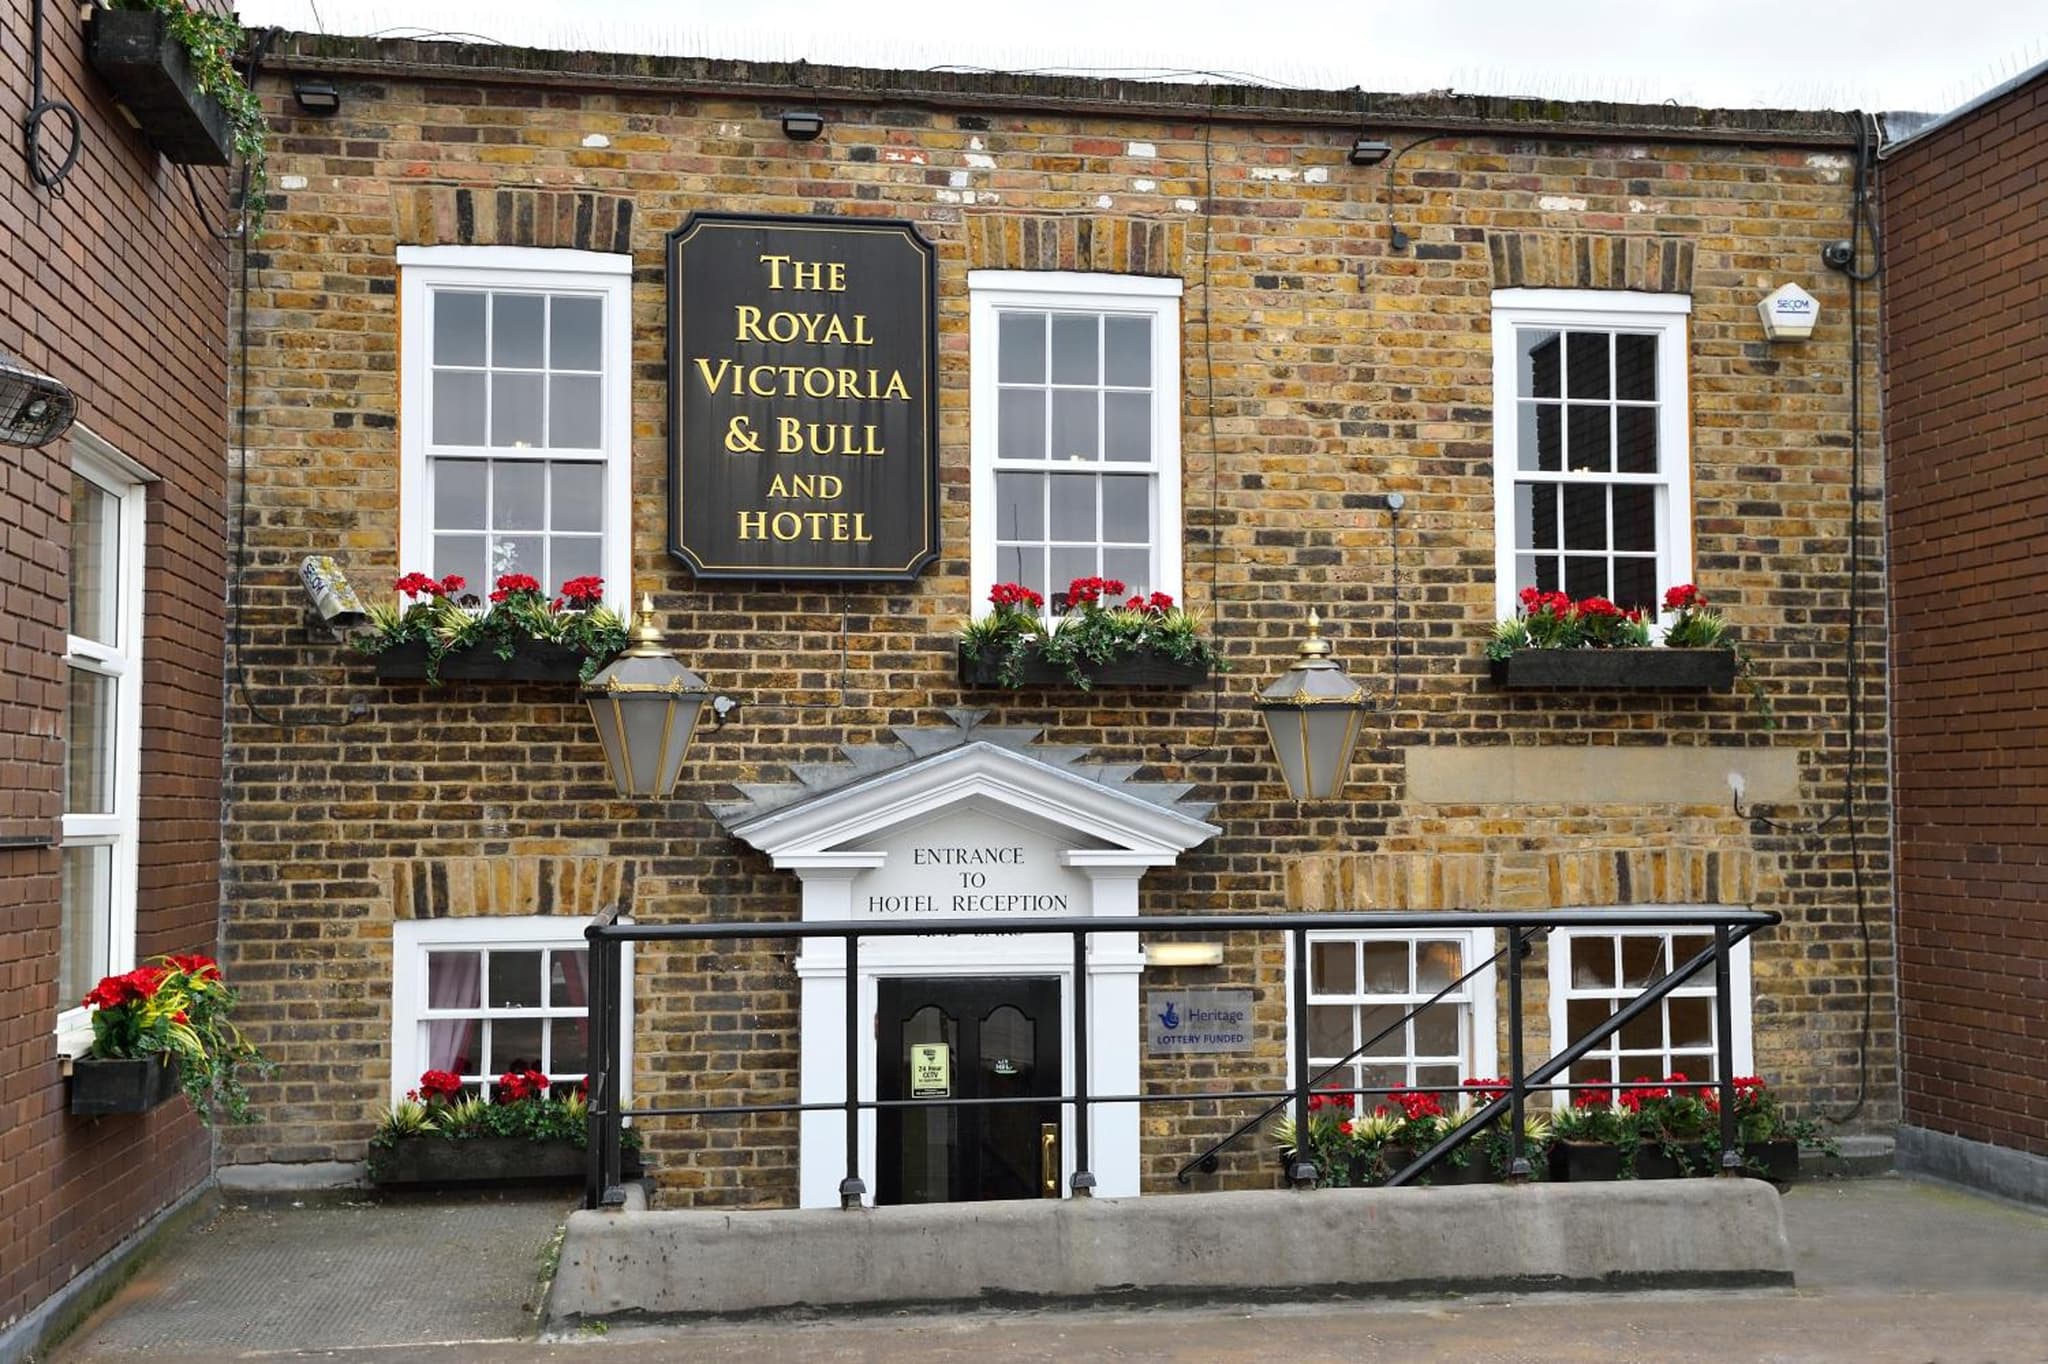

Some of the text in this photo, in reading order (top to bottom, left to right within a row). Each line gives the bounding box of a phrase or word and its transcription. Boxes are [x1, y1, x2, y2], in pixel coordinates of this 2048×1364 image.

[760, 255, 847, 292] THE
[1777, 299, 1809, 311] SECOM
[735, 305, 874, 345] ROYAL
[694, 358, 912, 399] VICTORIA
[725, 415, 884, 455] & BULL
[767, 474, 843, 499] AND
[738, 511, 873, 541] HOTEL
[914, 847, 1025, 864] ENTRANCE
[959, 872, 986, 888] TO
[869, 895, 1068, 913] HOTEL RECEPTION
[1189, 1008, 1243, 1024] Heritage
[1157, 1034, 1244, 1045] LOTTERY FUNDED
